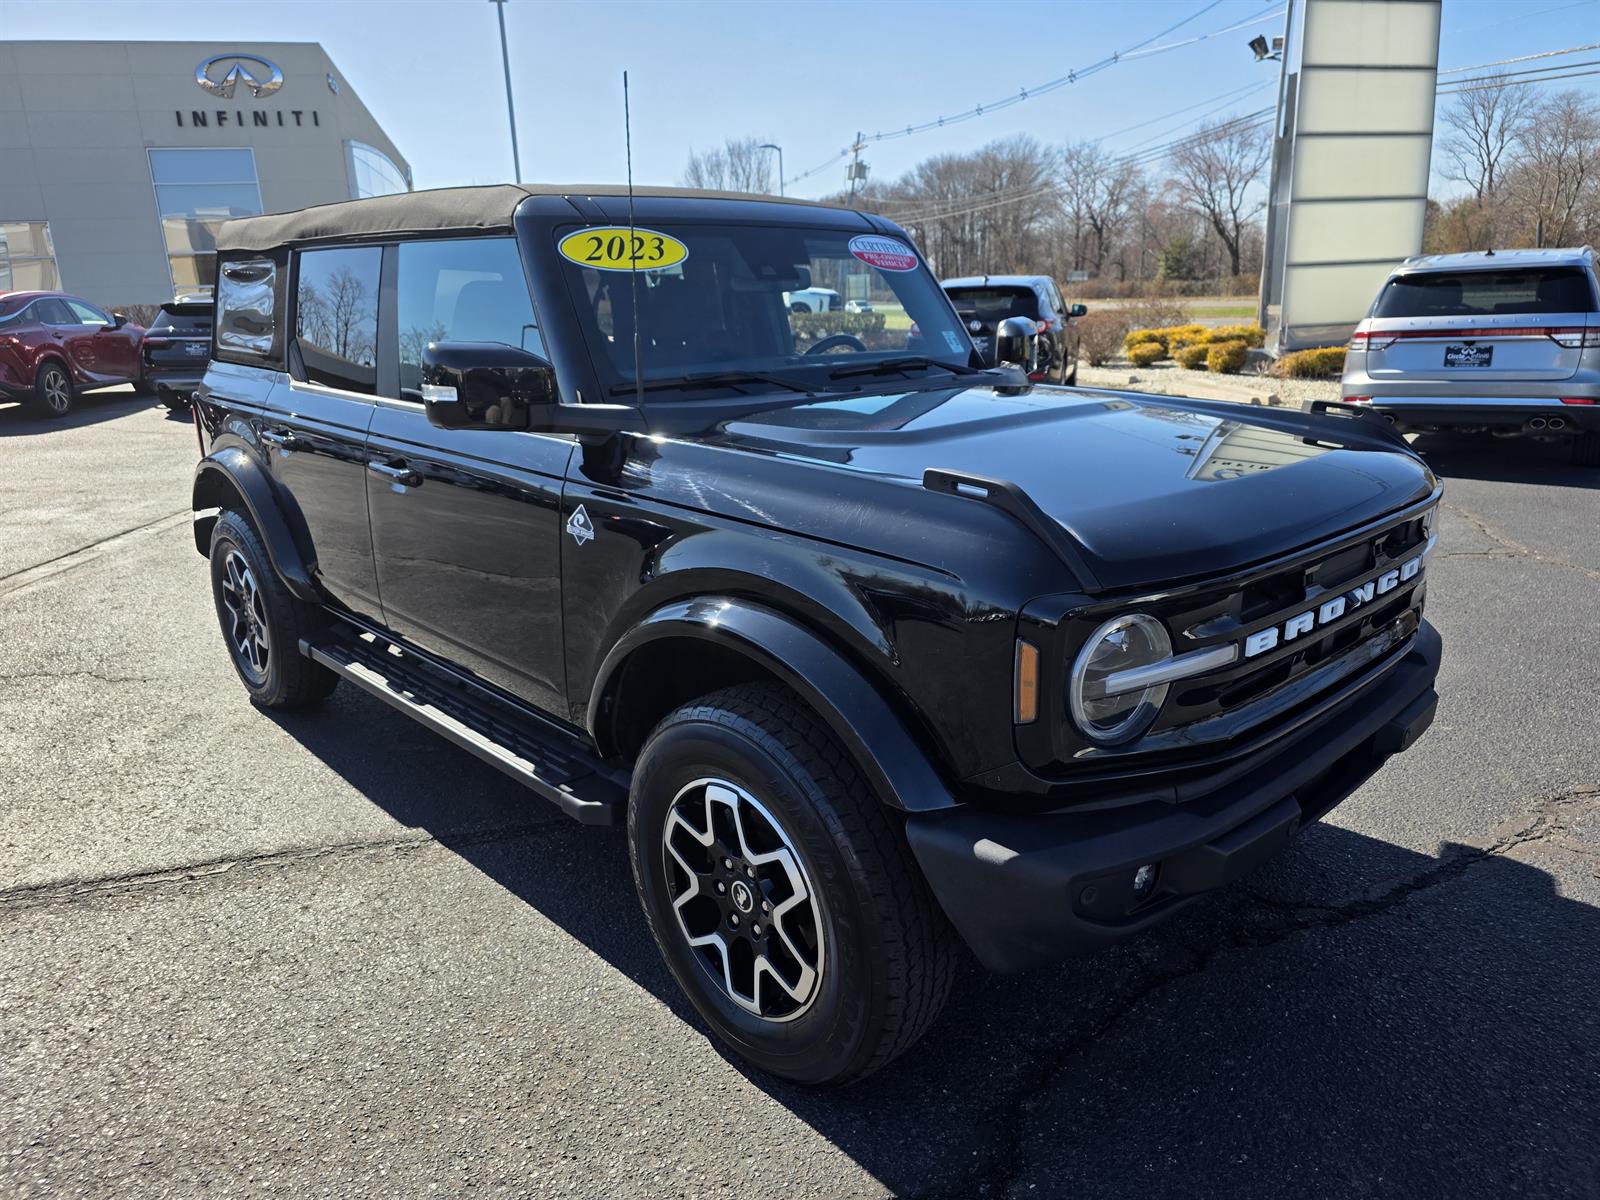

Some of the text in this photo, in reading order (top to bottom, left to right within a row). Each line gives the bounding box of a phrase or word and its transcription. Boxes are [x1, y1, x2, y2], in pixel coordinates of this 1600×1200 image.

[176, 110, 319, 127] INFINITI
[585, 235, 665, 261] 2023
[854, 240, 907, 254] CERTIFIED
[1245, 553, 1424, 658] BRONCO
